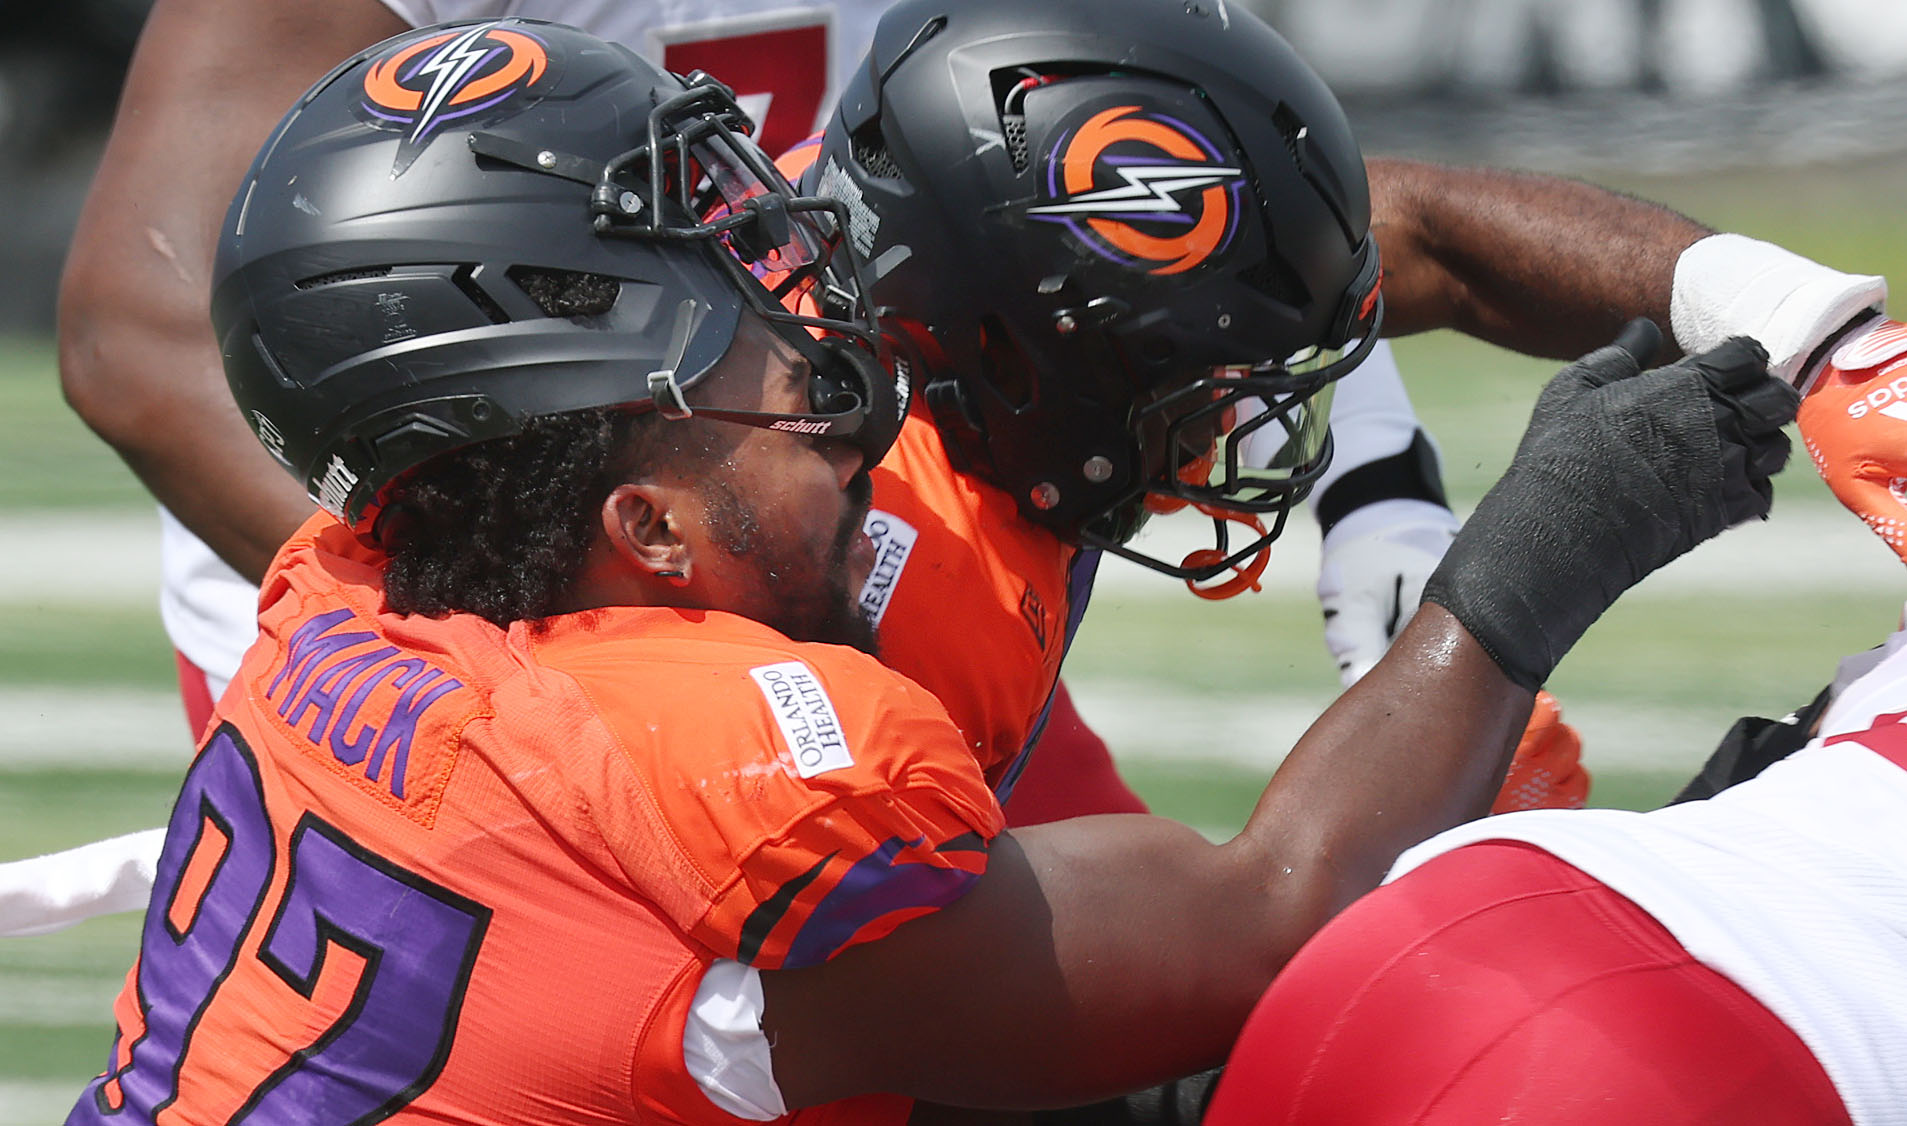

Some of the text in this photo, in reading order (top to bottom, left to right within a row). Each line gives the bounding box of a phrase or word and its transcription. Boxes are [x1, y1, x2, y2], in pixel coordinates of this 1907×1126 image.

[769, 418, 832, 434] schutt
[265, 608, 464, 800] MACK
[763, 670, 823, 767] ORLANDO
[790, 673, 842, 749] HEALTH
[62, 720, 494, 1126] 97
